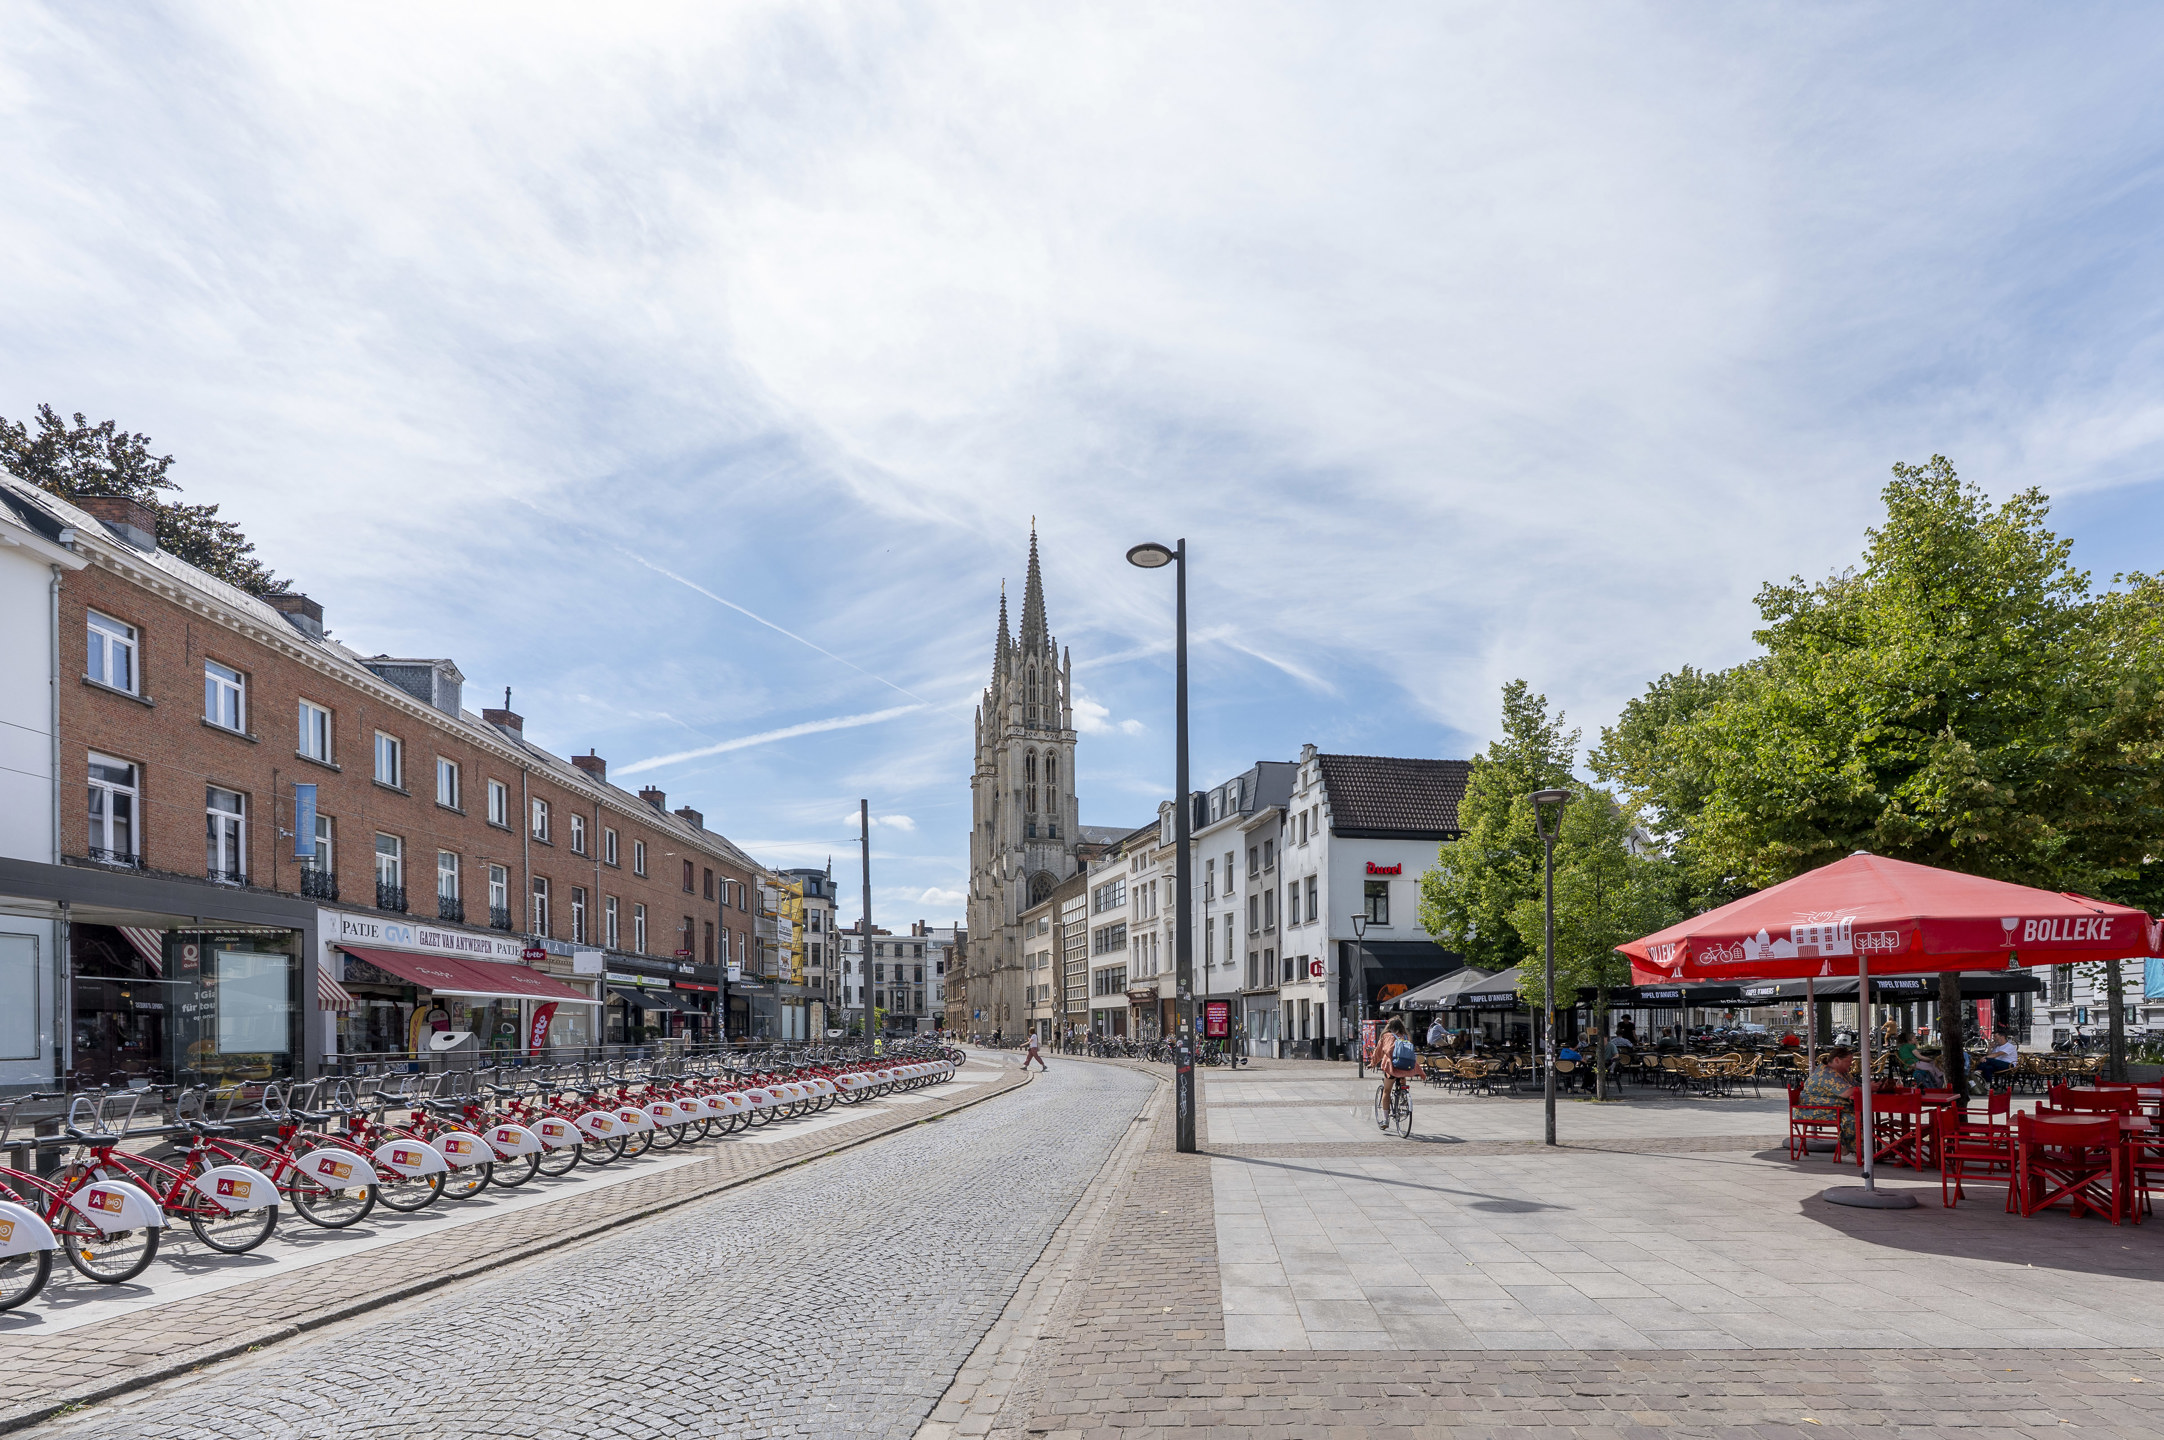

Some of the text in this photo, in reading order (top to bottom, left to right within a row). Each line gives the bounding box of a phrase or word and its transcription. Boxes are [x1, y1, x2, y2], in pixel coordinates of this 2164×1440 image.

[1366, 861, 1402, 875] Duvel
[342, 920, 412, 944] PATJE GVA
[2024, 918, 2114, 942] BOLLEKE
[420, 931, 492, 954] GAZET VAN ANTWERPEN
[497, 943, 520, 956] PATJE
[1647, 943, 1676, 962] OLLEKE
[1877, 980, 1920, 988] TRIPEL D'ANVERS
[1641, 990, 1679, 999] TRIPEL D'ANVERS
[499, 1132, 506, 1140] A
[448, 1142, 455, 1150] A
[395, 1153, 404, 1162] A
[322, 1162, 331, 1172] A
[221, 1182, 230, 1192] A
[92, 1194, 101, 1205] A
